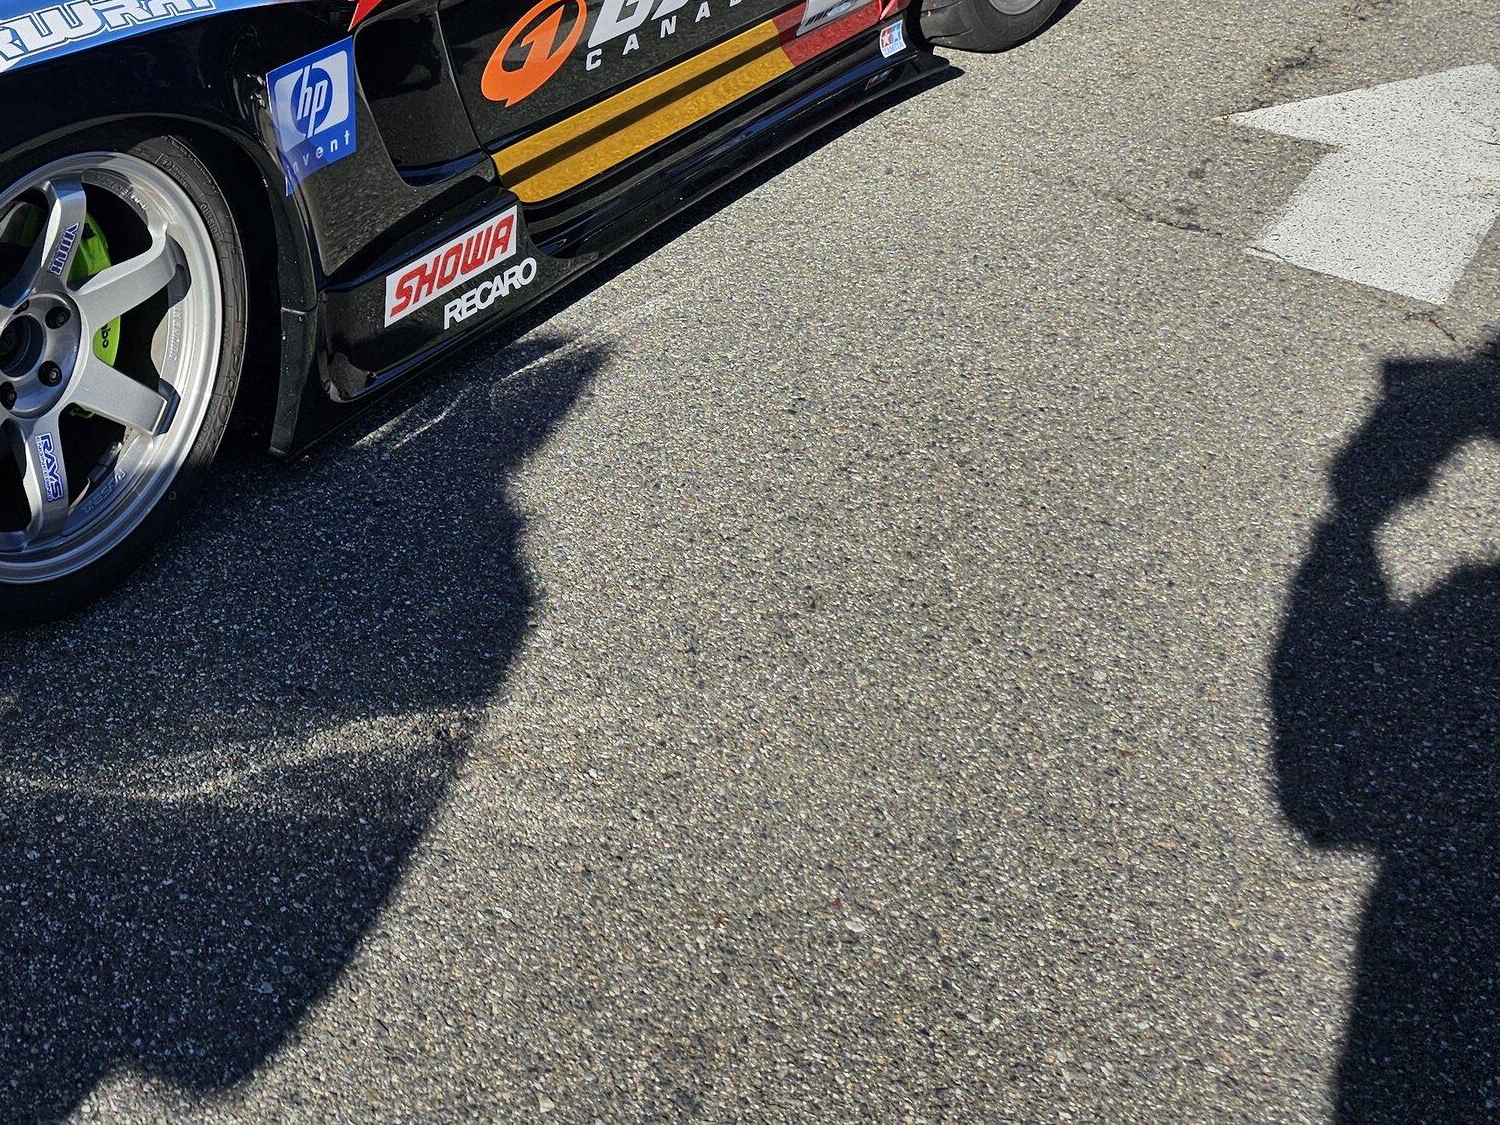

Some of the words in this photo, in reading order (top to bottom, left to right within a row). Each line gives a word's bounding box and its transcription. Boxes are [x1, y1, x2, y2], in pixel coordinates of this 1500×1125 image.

[296, 64, 329, 139] hp
[389, 213, 515, 318] SHOWA
[443, 257, 537, 330] RECARO
[40, 432, 64, 499] RAYS
